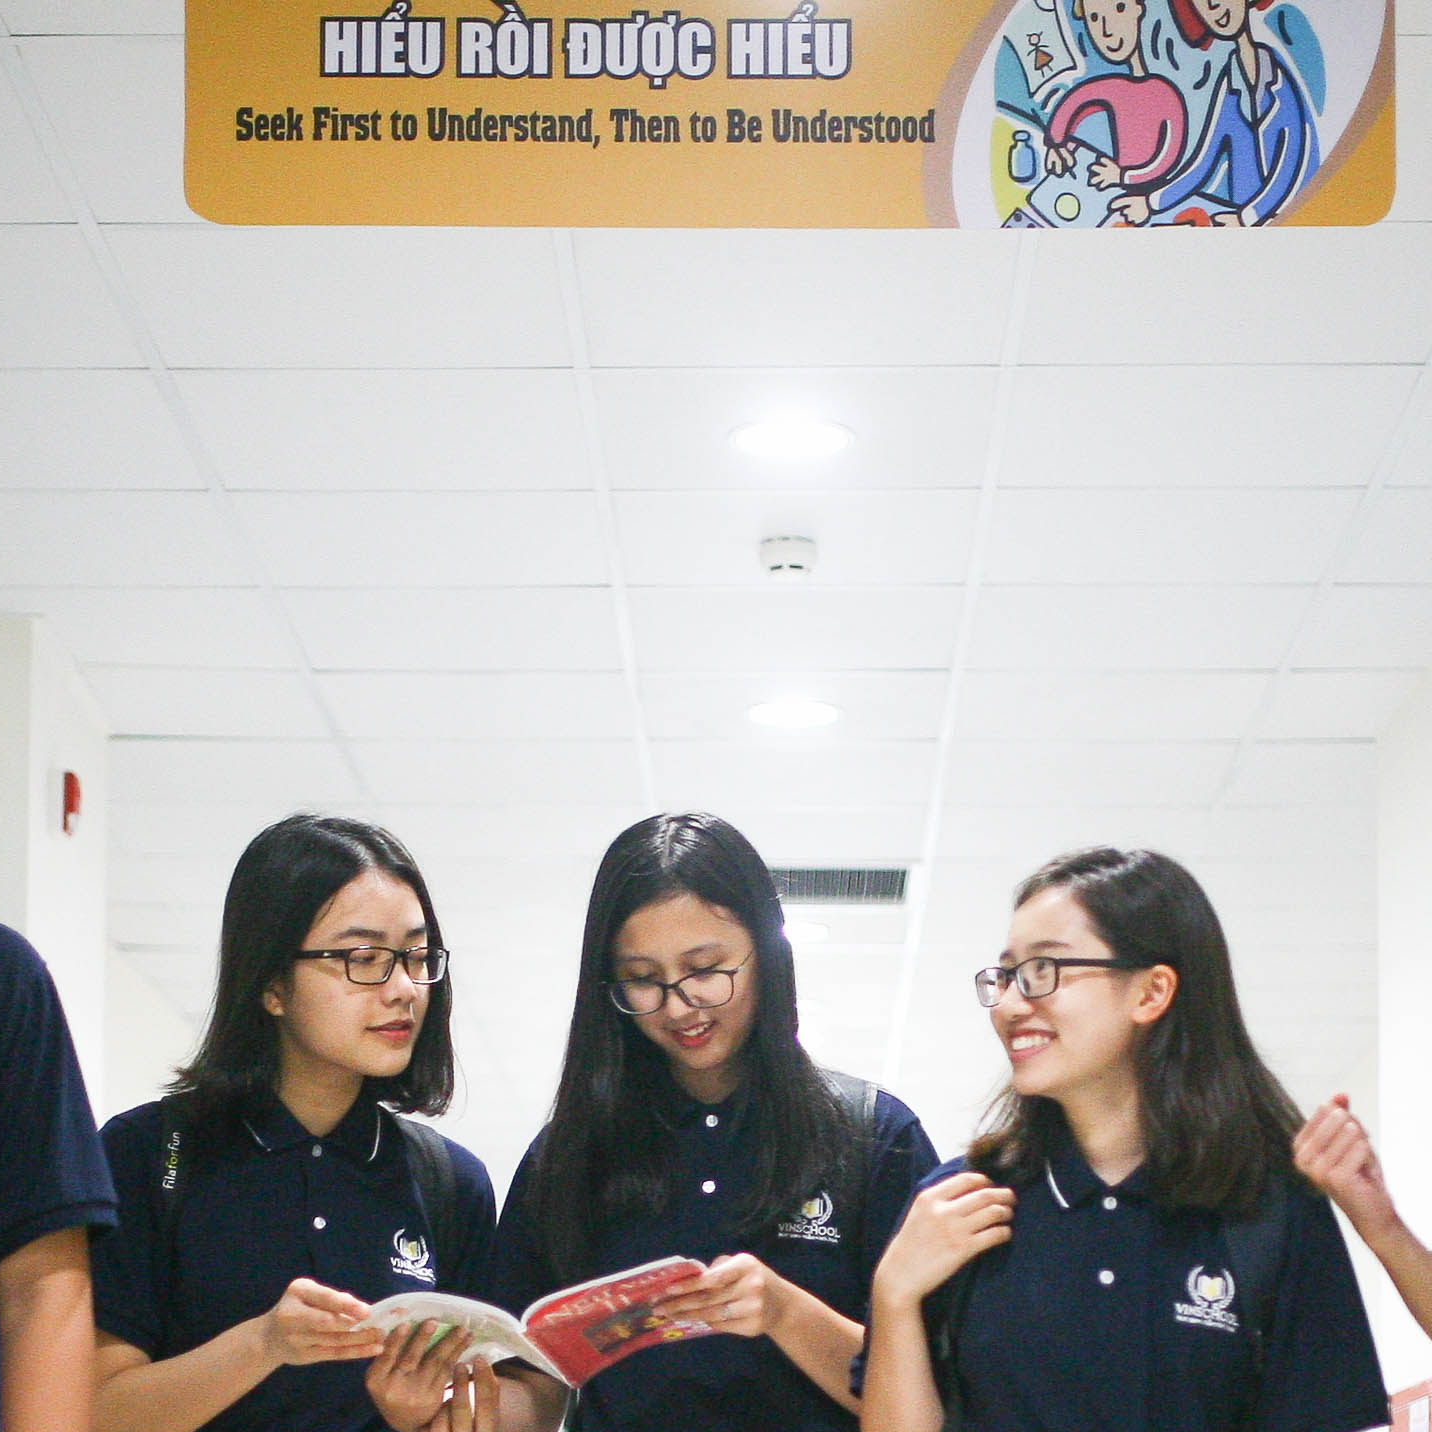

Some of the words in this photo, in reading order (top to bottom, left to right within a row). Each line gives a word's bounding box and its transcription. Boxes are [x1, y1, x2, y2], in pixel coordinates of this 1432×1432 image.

[322, 1, 444, 77] HIỂU
[457, 2, 552, 78] RỒI
[563, 10, 715, 88] ĐƯỢC
[728, 1, 852, 79] HIỂU
[235, 107, 303, 141] Seek
[313, 107, 381, 141] First
[390, 109, 418, 141] to
[427, 108, 601, 148] Understand,
[610, 109, 680, 143] Then
[690, 111, 717, 143] to
[726, 109, 762, 143] Be
[772, 109, 936, 144] Understood
[778, 1222, 841, 1238] VINSCHOOL
